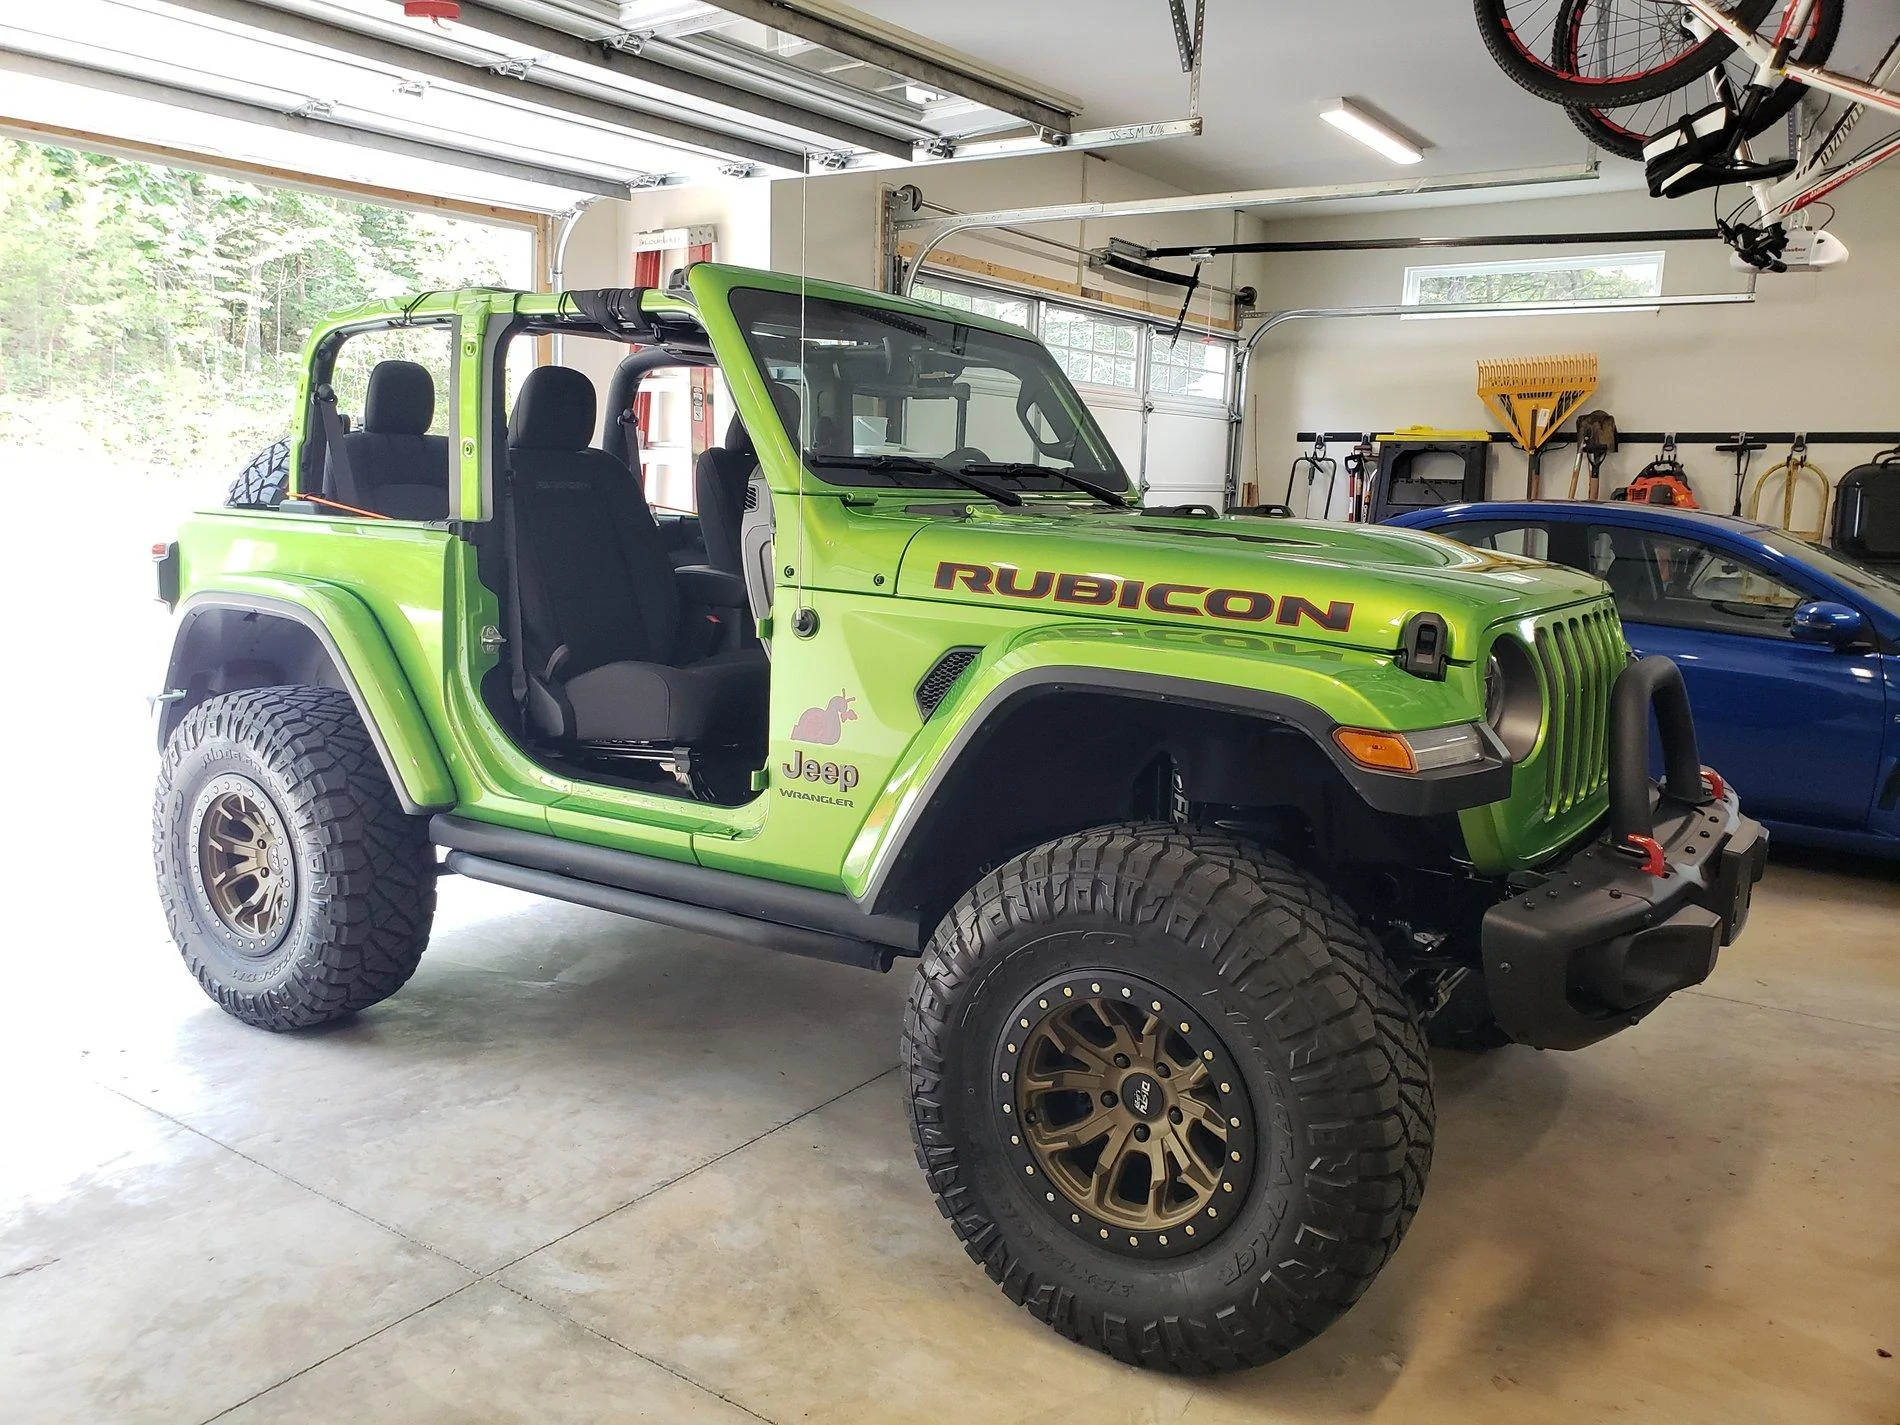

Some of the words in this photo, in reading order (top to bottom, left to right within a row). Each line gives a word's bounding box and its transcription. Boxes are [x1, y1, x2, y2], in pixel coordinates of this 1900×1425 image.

[934, 561, 1354, 632] RUBICON
[782, 750, 859, 792] Jeep
[779, 787, 854, 808] WRANGLER
